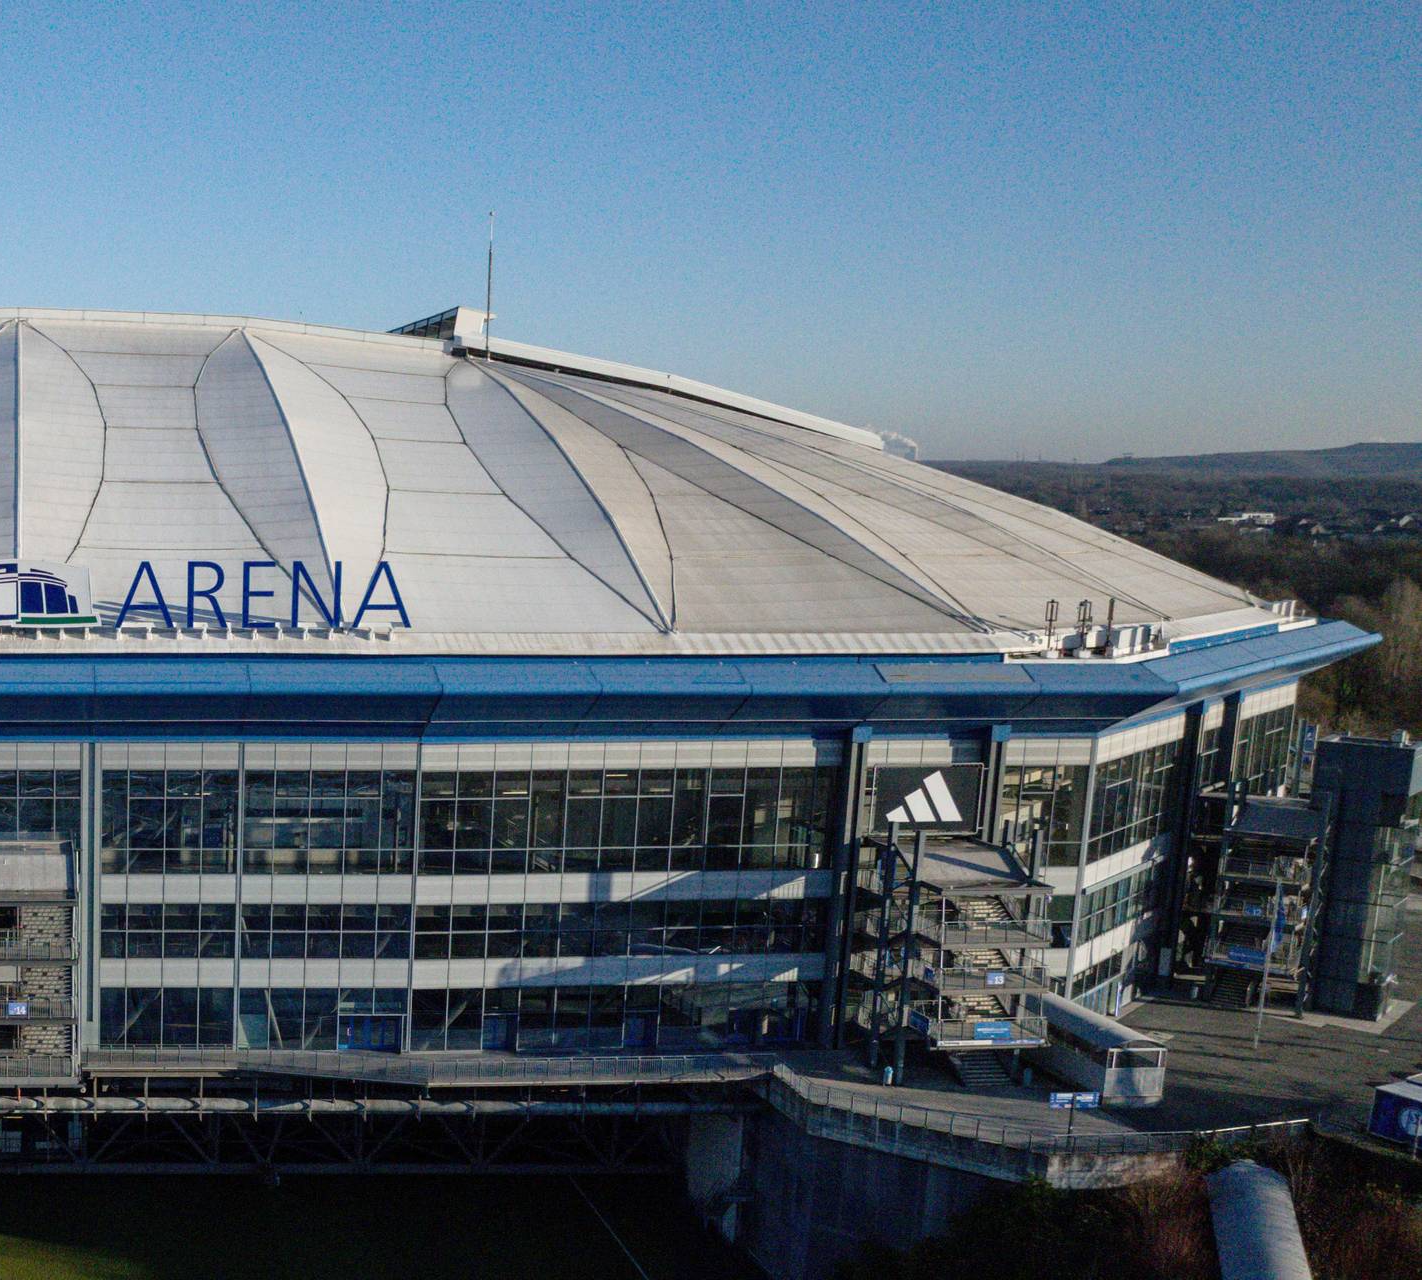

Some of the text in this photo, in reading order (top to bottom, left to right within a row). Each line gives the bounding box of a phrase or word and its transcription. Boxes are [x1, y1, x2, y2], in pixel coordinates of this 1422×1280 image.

[115, 560, 411, 629] ARENA
[993, 975, 1005, 985] 13
[16, 1005, 27, 1015] 14
